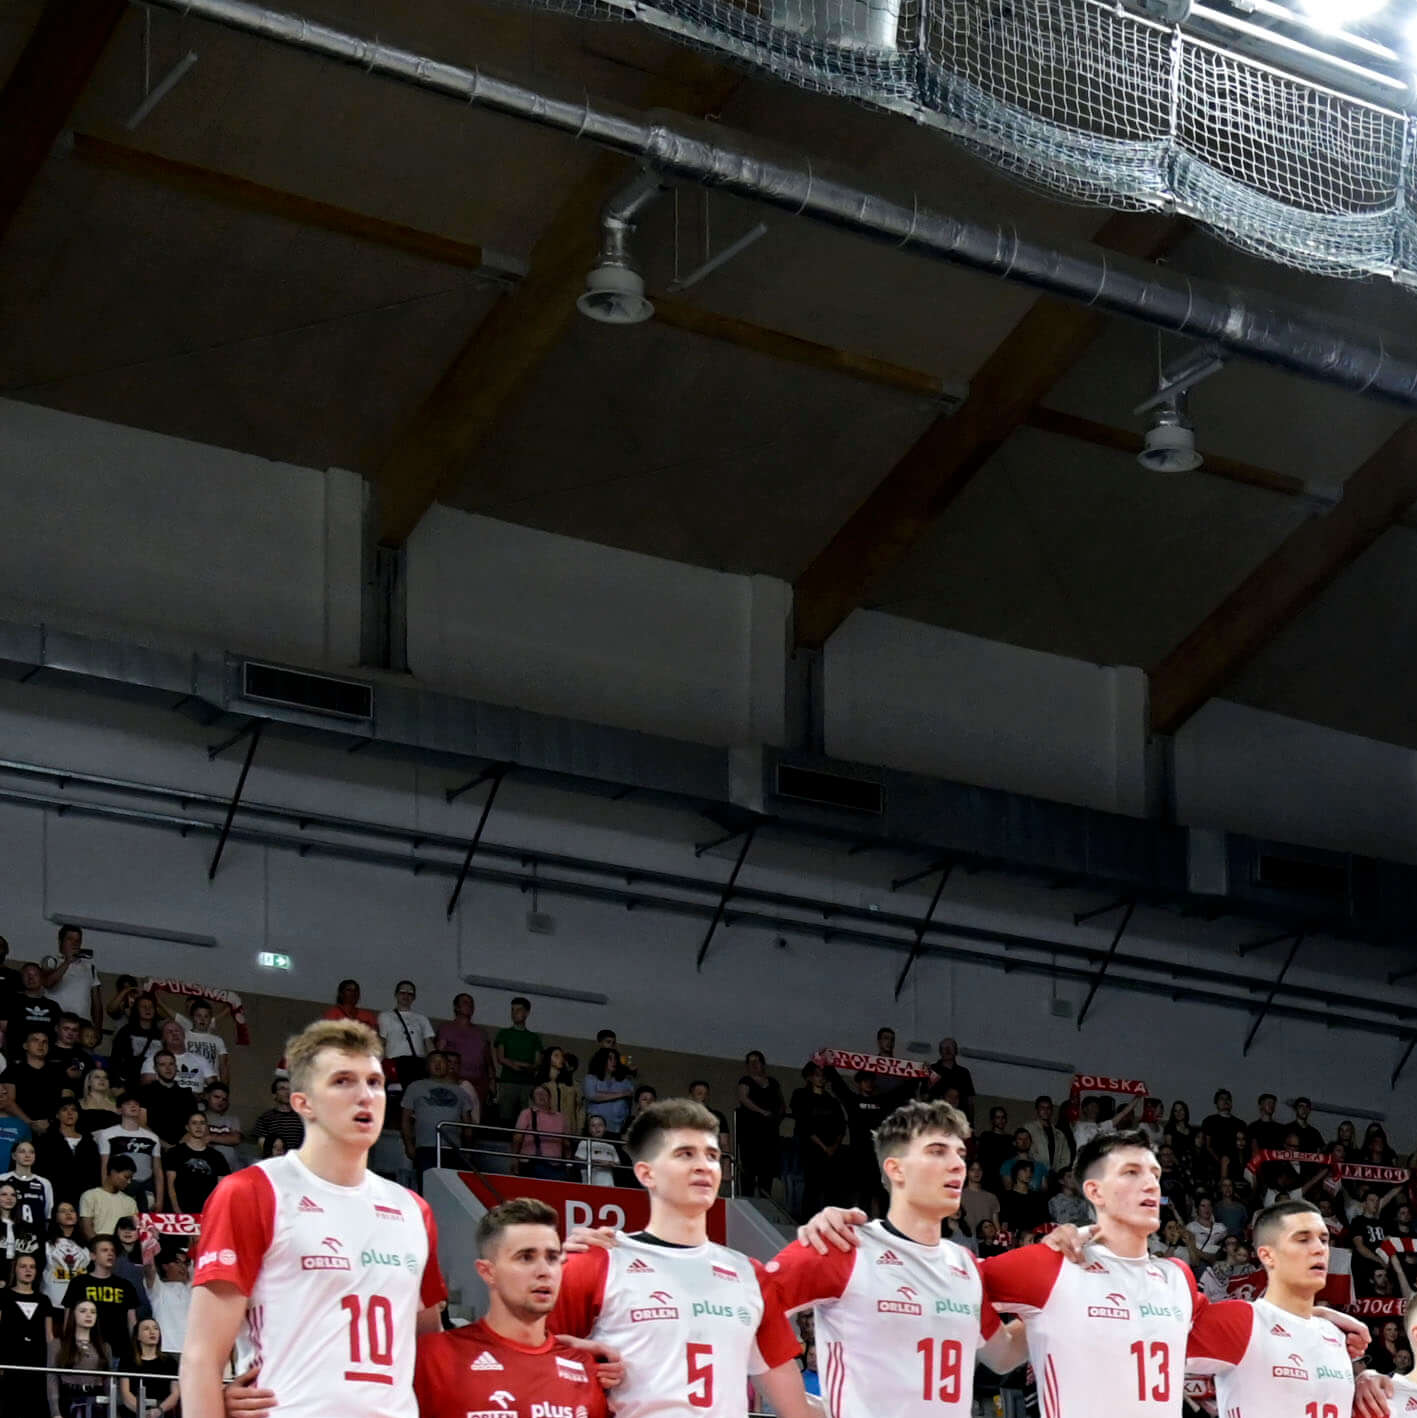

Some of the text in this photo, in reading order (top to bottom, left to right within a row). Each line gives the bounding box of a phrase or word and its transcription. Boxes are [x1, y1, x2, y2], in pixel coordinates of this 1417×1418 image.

[839, 1051, 917, 1077] POLSKA
[303, 1257, 349, 1269] ORLEN
[361, 1249, 400, 1267] plus
[86, 1286, 124, 1303] RIDE
[633, 1309, 676, 1320] ORLEN
[692, 1301, 734, 1317] plus
[880, 1302, 920, 1315] ORLEN
[936, 1299, 970, 1316] plus
[1090, 1307, 1128, 1319] ORLEN
[1139, 1303, 1171, 1319] plus
[341, 1295, 393, 1365] 10
[687, 1343, 713, 1408] 5
[917, 1337, 962, 1402] 19
[1130, 1341, 1170, 1401] 13
[1274, 1367, 1307, 1379] ORLEN
[1317, 1366, 1344, 1381] plus
